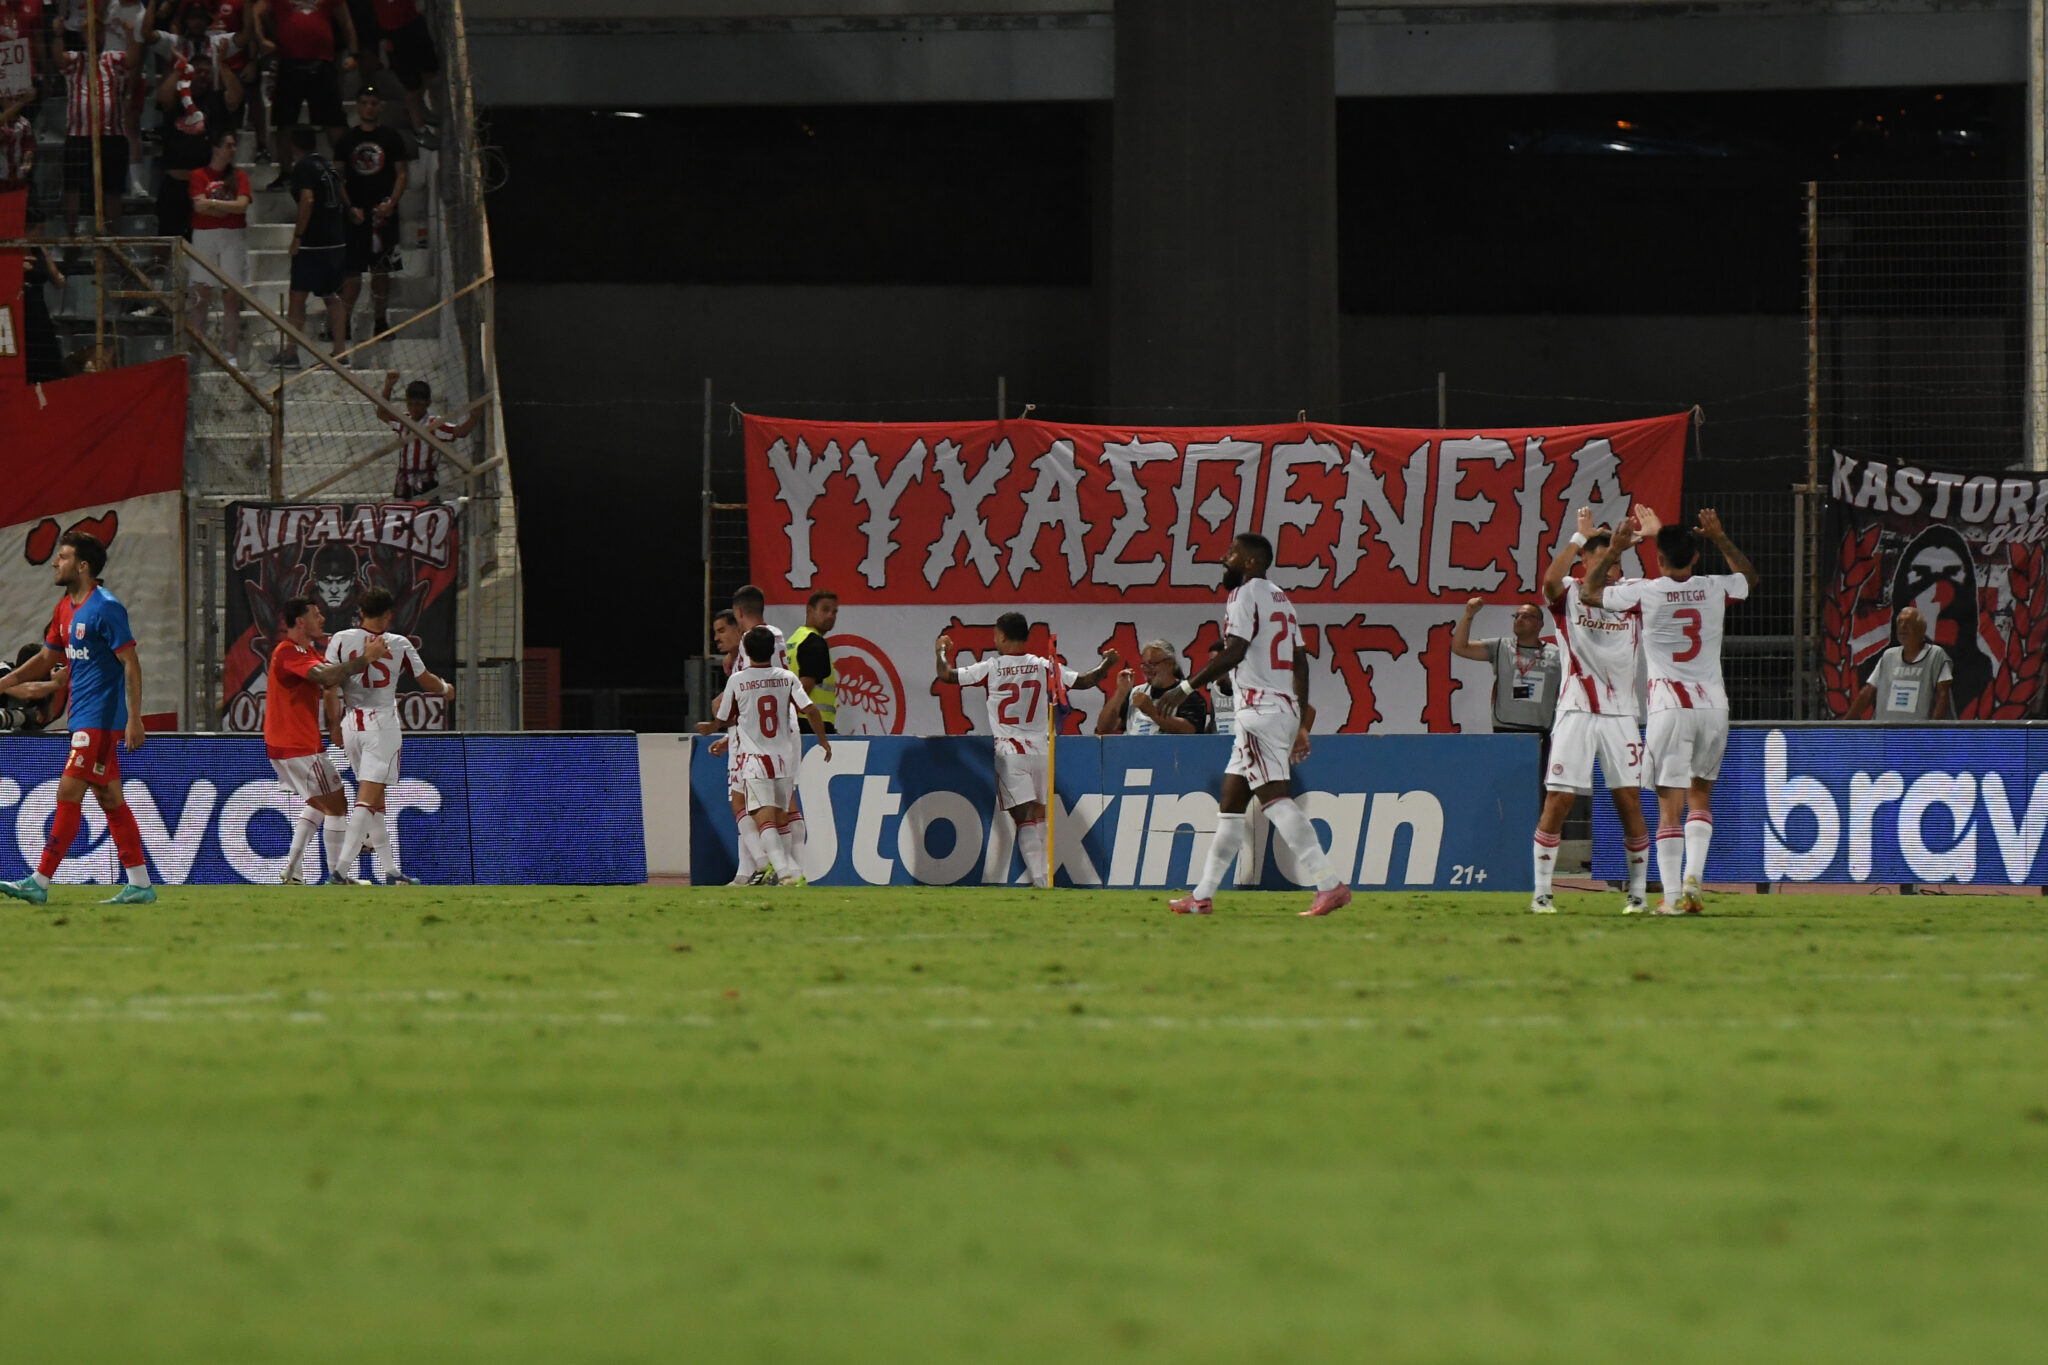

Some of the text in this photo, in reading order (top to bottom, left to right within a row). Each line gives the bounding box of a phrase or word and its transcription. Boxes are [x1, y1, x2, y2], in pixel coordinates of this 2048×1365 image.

[234, 506, 452, 569] ΑΙΓΑΛΕΩ
[1666, 590, 1706, 602] ORTEGA
[1575, 614, 1630, 631] Stoiximan
[1672, 608, 1702, 662] 3
[997, 665, 1039, 677] STREFEZZA
[739, 678, 789, 691] D.NASCIMENTO
[998, 680, 1042, 724] 27
[757, 694, 778, 739] 8
[1450, 864, 1488, 885] 21+
